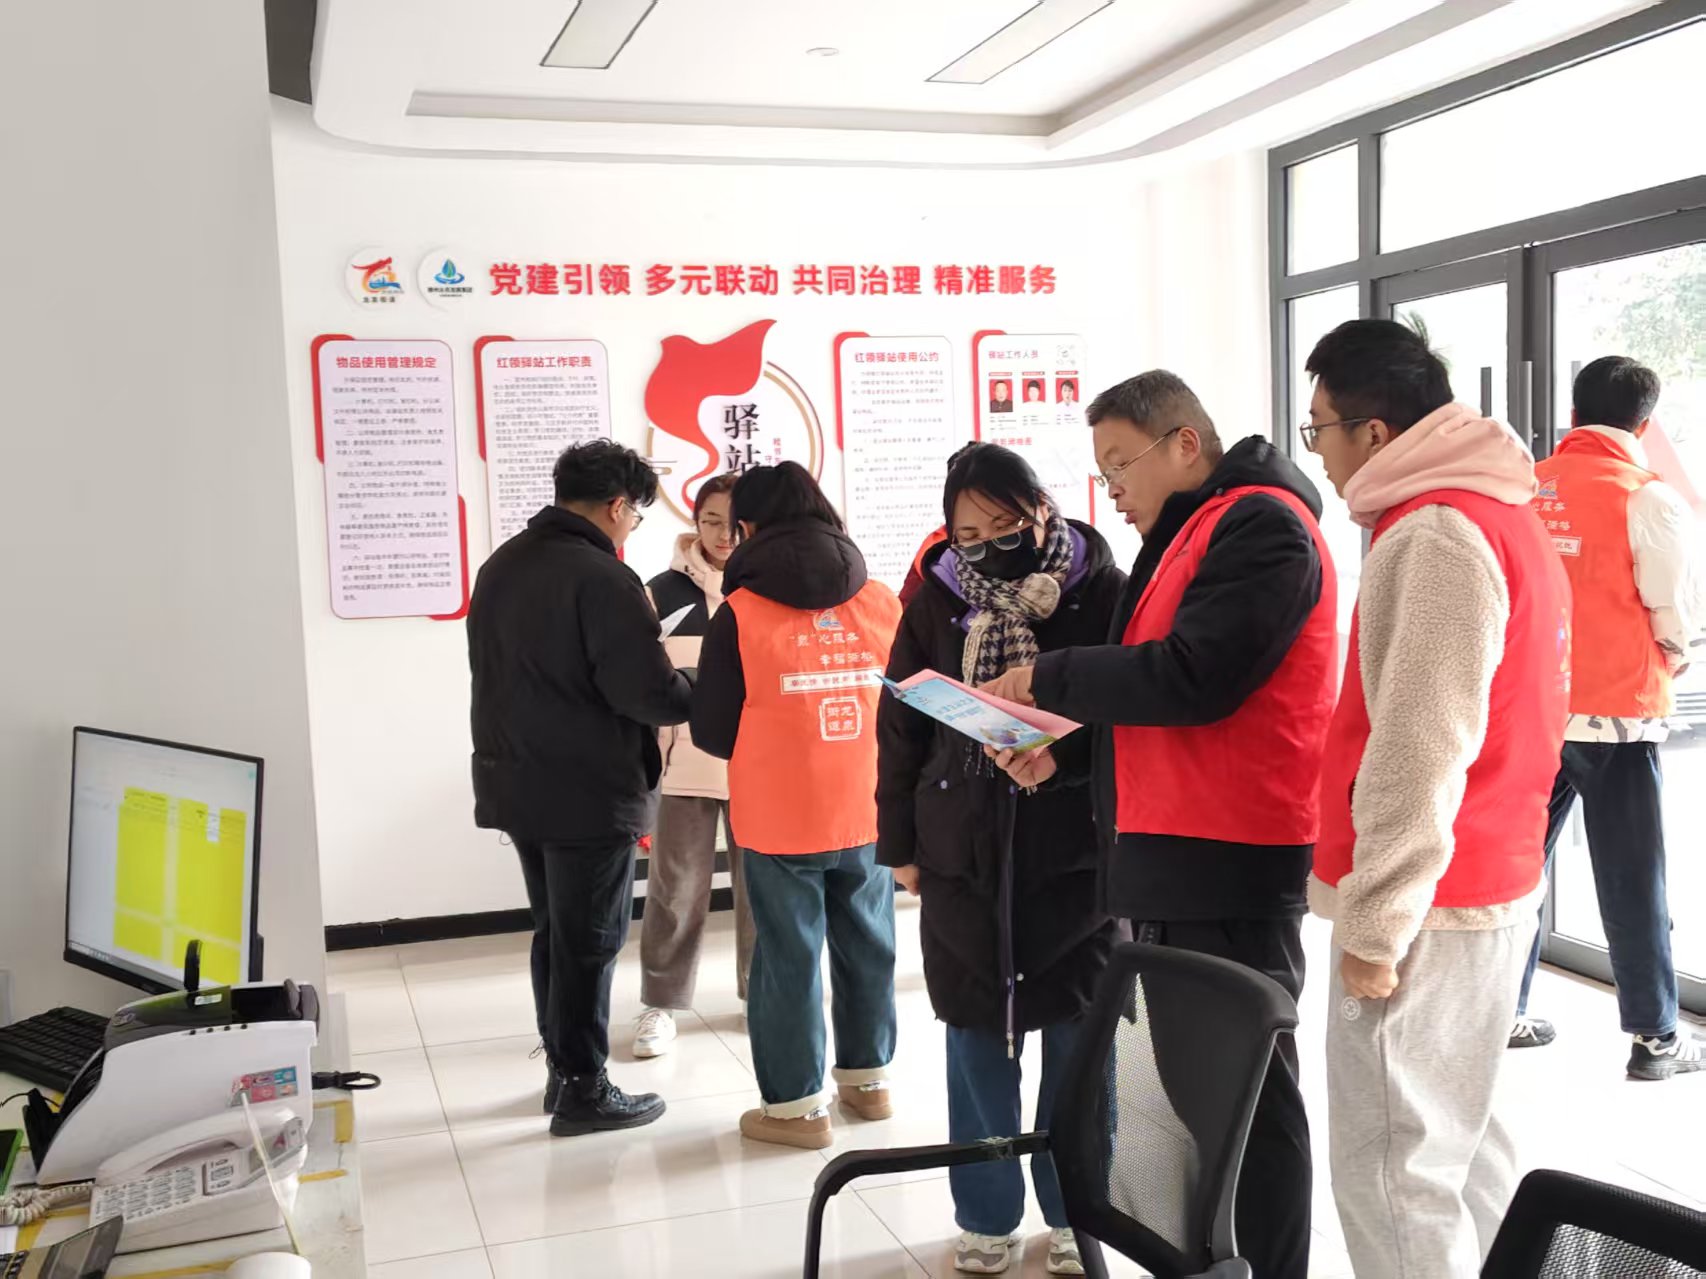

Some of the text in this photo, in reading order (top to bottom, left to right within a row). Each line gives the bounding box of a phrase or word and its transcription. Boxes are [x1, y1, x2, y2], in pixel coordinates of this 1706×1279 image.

[489, 262, 1057, 296] 党建引领 多元联动 共同治理 精准服务
[336, 356, 437, 369] 物品使用管理规定
[496, 356, 593, 369] 红领驿站工作职责
[854, 351, 940, 363] 红领驿站使用公约
[723, 403, 761, 475] 驿站
